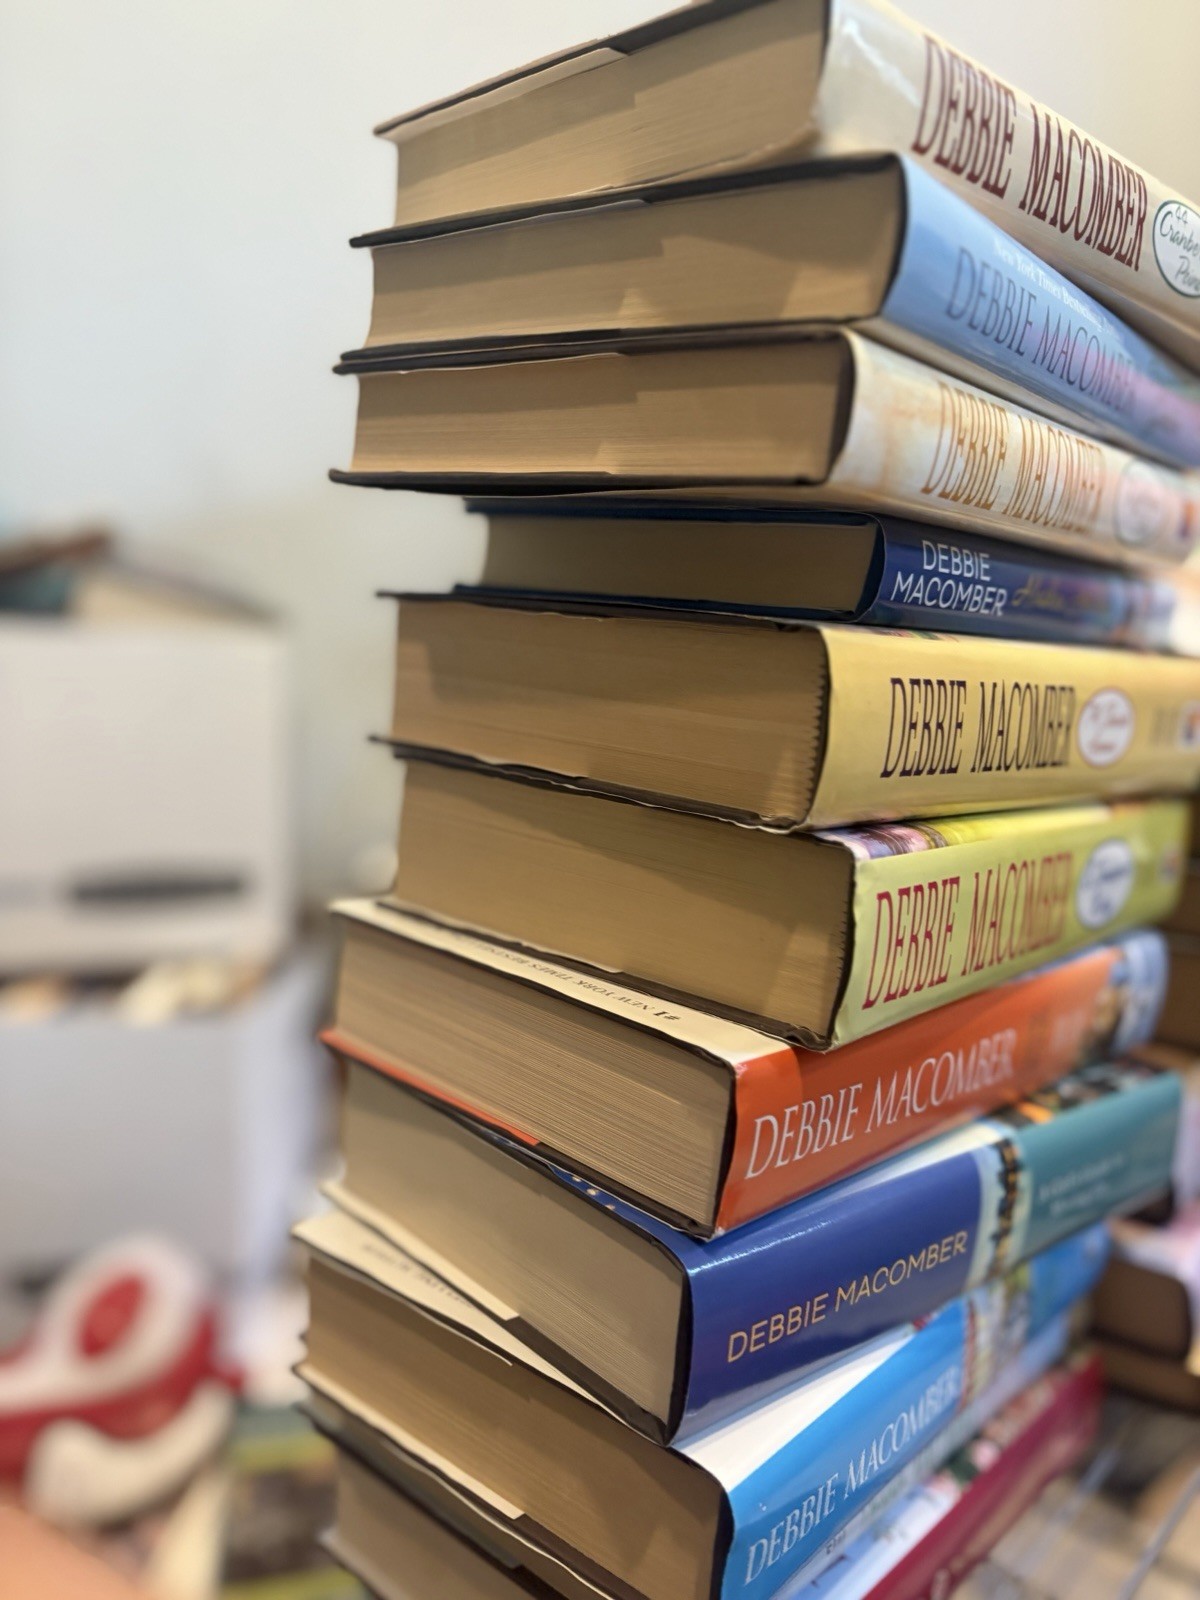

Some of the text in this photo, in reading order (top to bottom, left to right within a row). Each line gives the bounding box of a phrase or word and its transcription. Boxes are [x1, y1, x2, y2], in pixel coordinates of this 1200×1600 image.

[911, 33, 1148, 272] DEBBIE MACOMBER
[945, 247, 1037, 357] DEBBIE
[920, 381, 1009, 511] DEBBIE
[1001, 414, 1106, 535] MACOMBER
[890, 571, 1008, 617] MACOMBER
[921, 540, 991, 582] DEBBIE
[880, 677, 967, 778] DEBBIE
[970, 680, 1076, 773] MACOMBER
[528, 964, 574, 981] TIMES
[862, 877, 960, 1010] DEBBIE
[960, 851, 1074, 976] MACOMBER
[572, 979, 614, 997] YORK
[613, 996, 654, 1011] NEW
[653, 1010, 681, 1022] #1
[745, 1083, 863, 1180] DEBBIE
[865, 1028, 1018, 1134] MACOMBER
[727, 1230, 968, 1364] DEBBIE MACOMBER
[744, 1366, 961, 1588] DEBBIE MACOMBER
